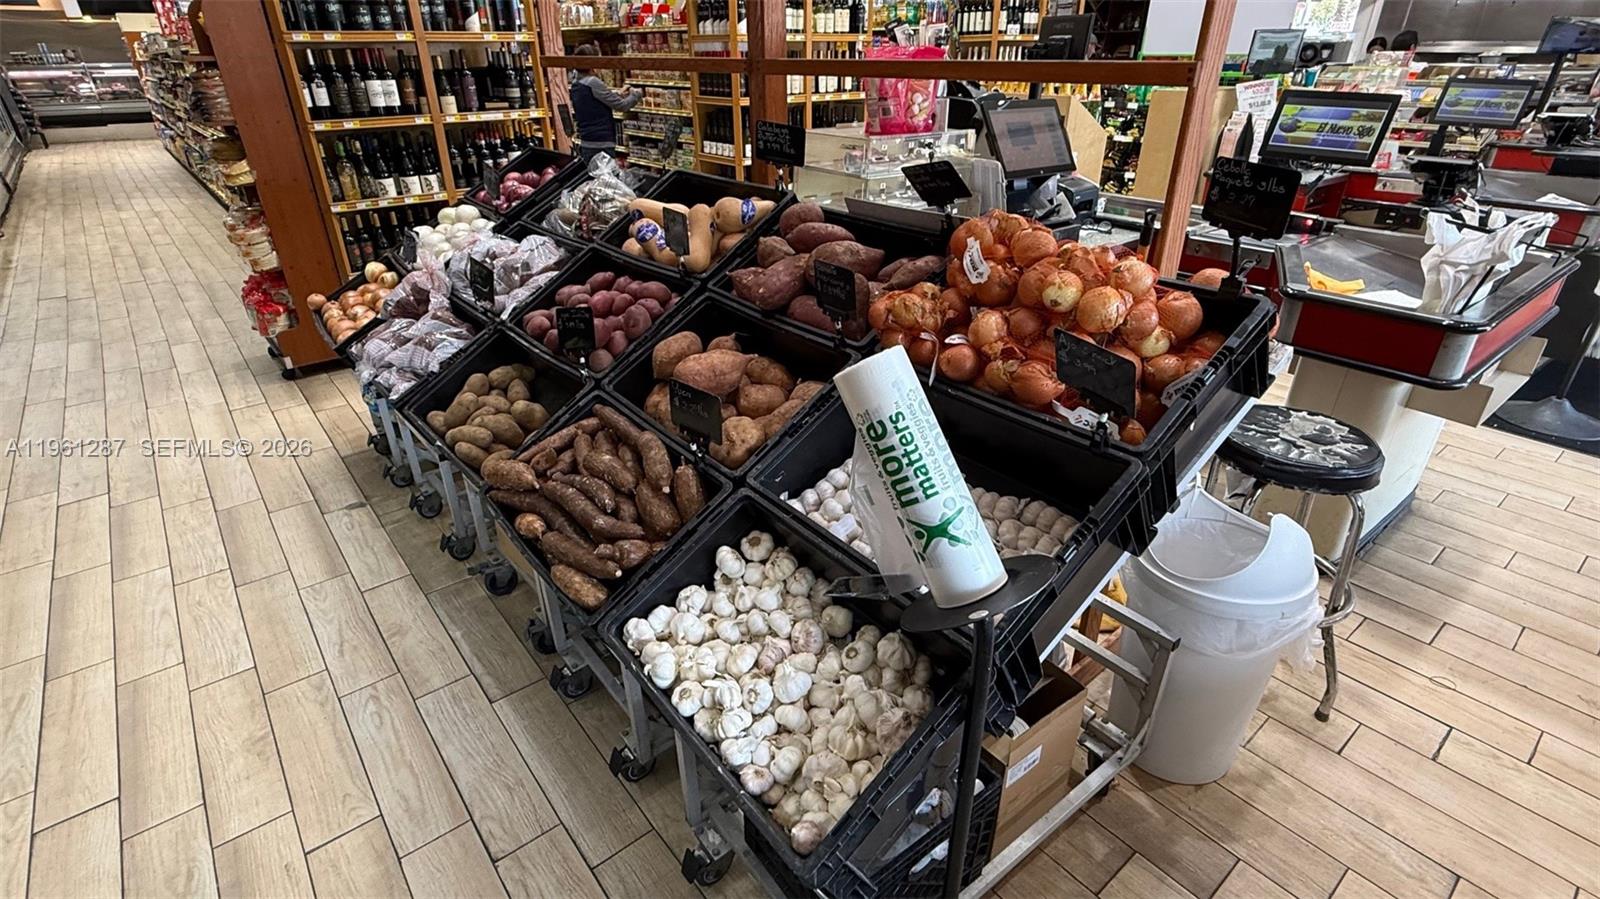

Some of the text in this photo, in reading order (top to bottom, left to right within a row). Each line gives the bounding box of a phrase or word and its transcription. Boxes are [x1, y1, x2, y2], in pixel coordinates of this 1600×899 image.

[1216, 158, 1251, 176] Cebolla
[888, 410, 940, 502] matters
[906, 402, 932, 449] veggies
[866, 418, 920, 509] more
